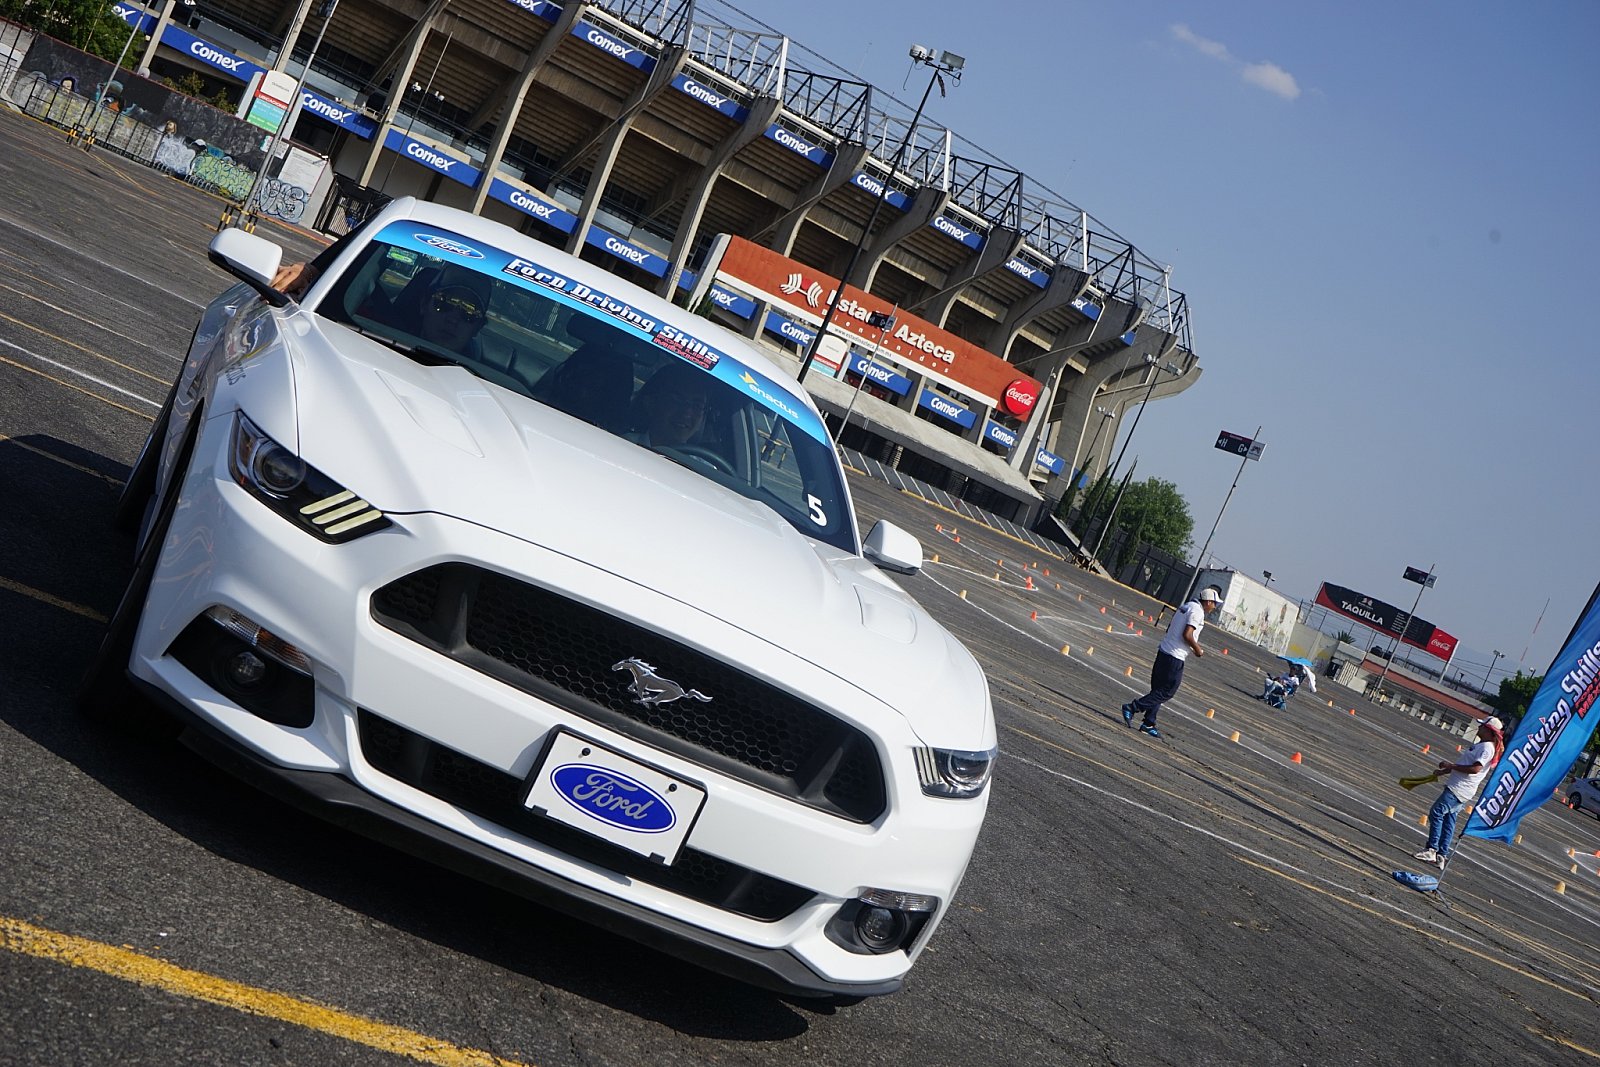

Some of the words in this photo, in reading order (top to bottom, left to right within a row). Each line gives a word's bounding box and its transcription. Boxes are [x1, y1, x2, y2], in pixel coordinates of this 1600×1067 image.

[190, 41, 246, 72] Comex
[587, 30, 634, 59] Comex
[302, 92, 353, 123] Comex
[683, 80, 728, 109] Comex
[407, 142, 457, 171] Comex
[774, 129, 816, 156] Comex
[509, 191, 557, 219] Comex
[934, 216, 971, 241] Comex
[605, 237, 650, 264] Comex
[1005, 259, 1037, 279] omex
[709, 288, 738, 307] mex
[570, 283, 656, 333] Driving
[660, 325, 720, 363] Skills
[781, 322, 815, 344] Come
[826, 289, 898, 333] Esta
[893, 323, 956, 364] Azteca
[857, 360, 895, 383] Comex
[748, 384, 799, 419] enactus
[930, 397, 963, 418] Comex
[807, 493, 828, 527] 5
[1341, 600, 1384, 625] TAQUILLA
[1508, 698, 1572, 778] Driving
[572, 772, 655, 820] Ford
